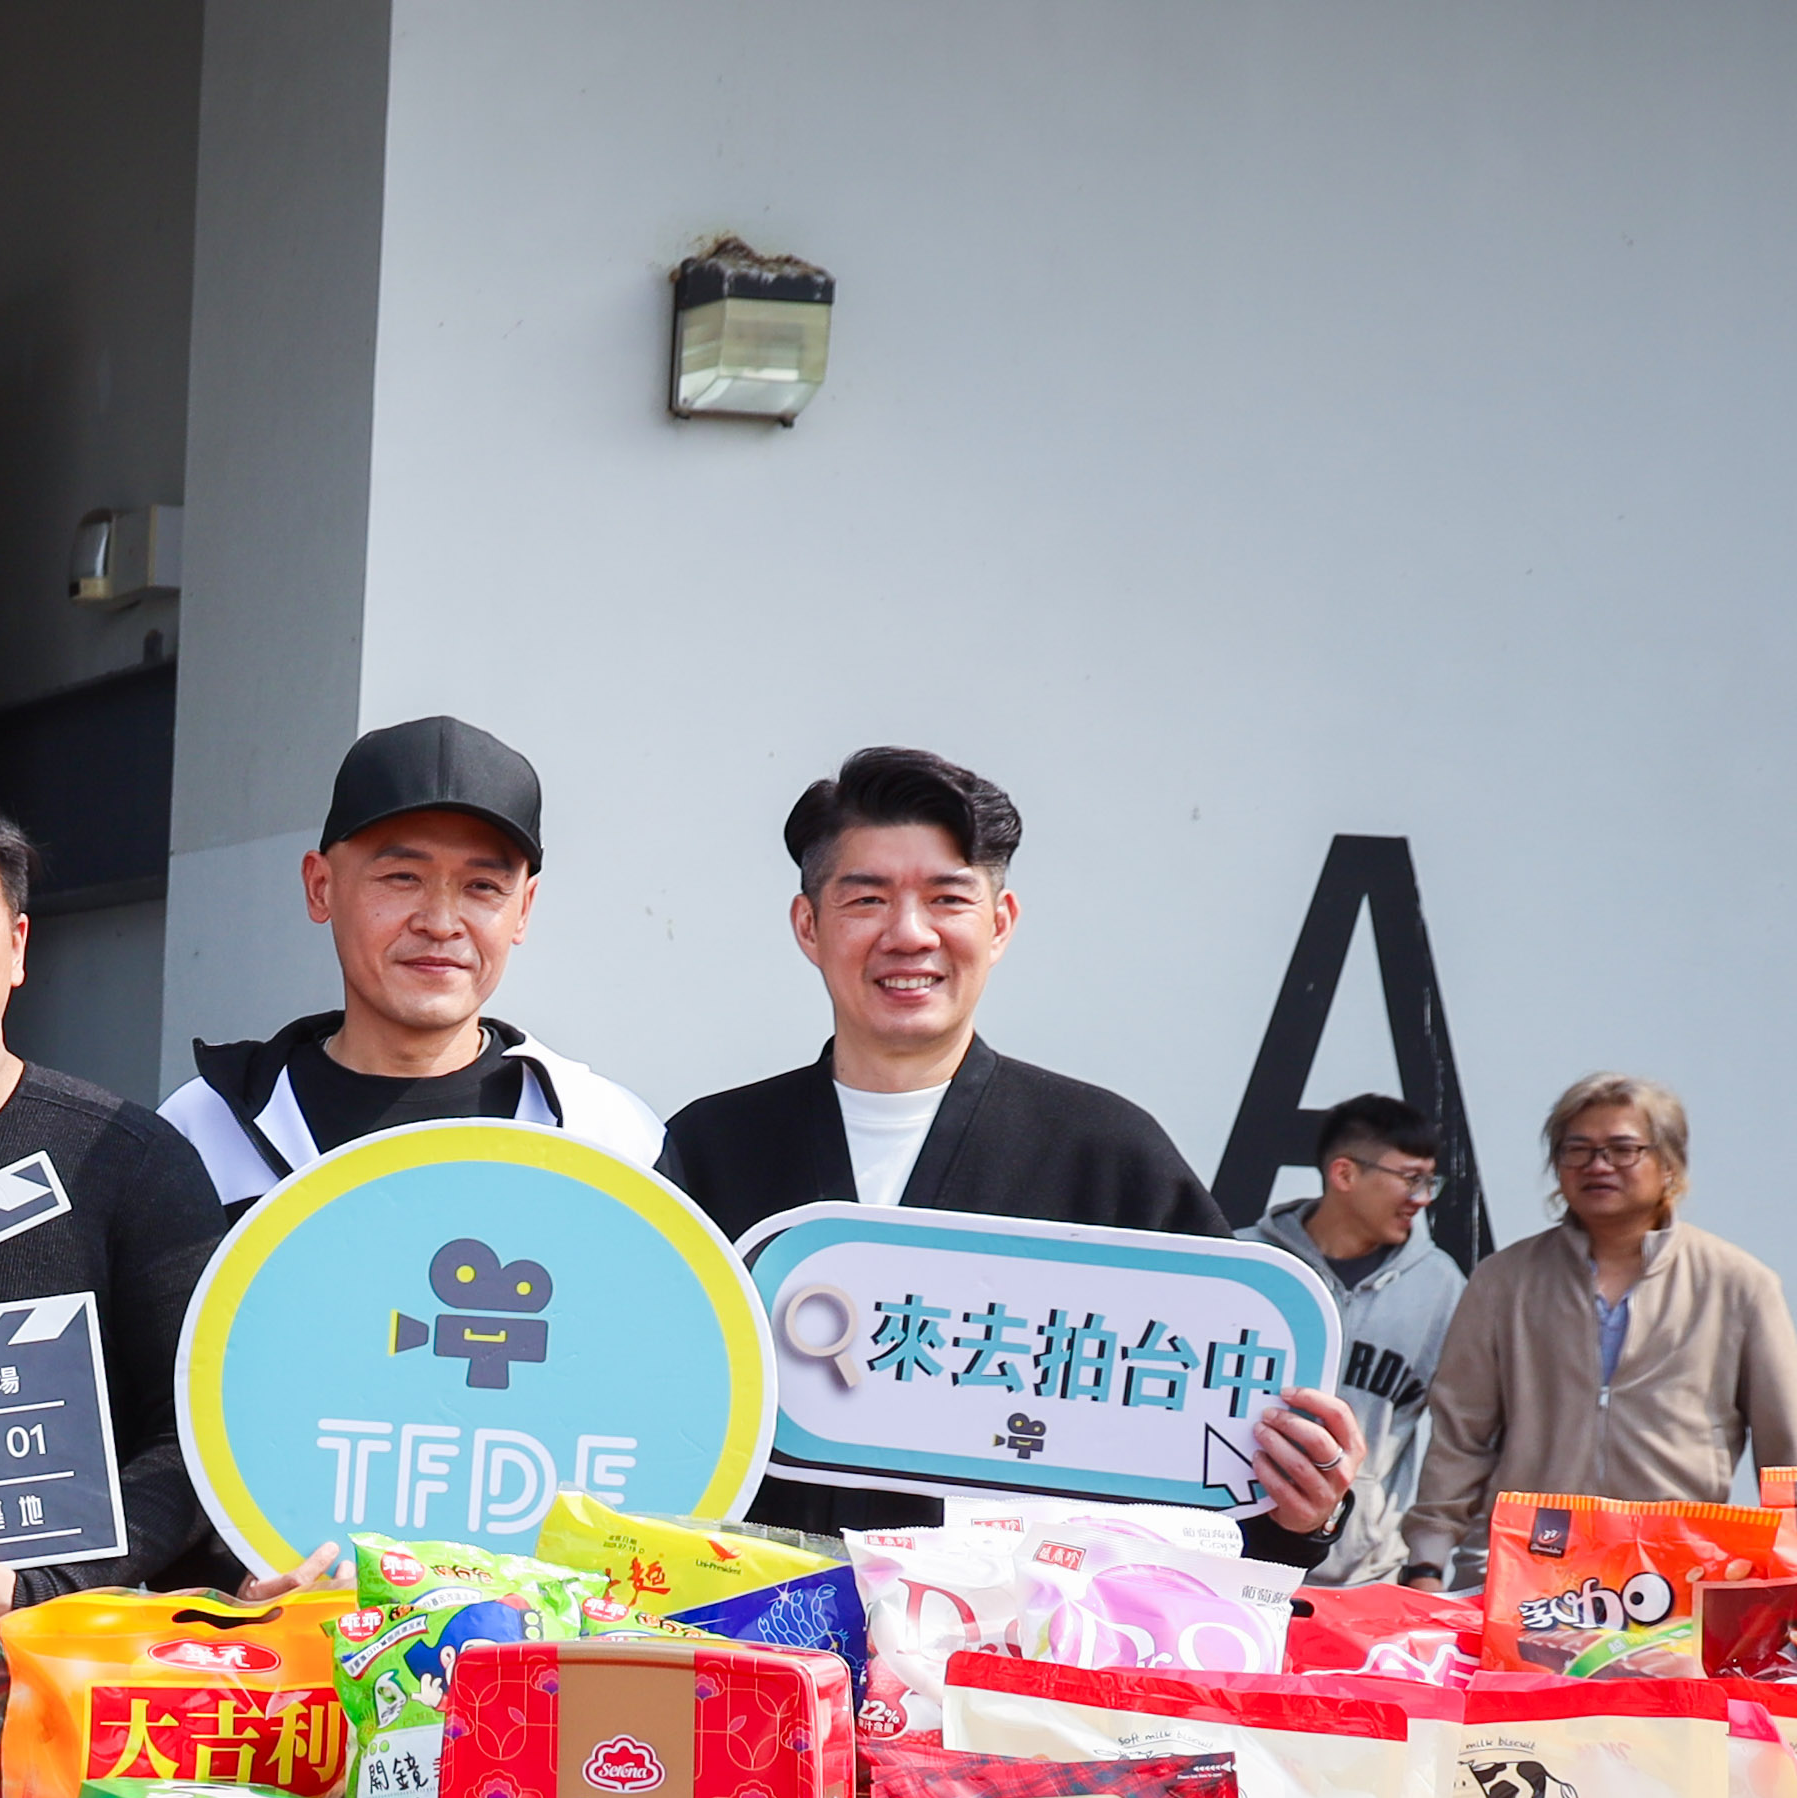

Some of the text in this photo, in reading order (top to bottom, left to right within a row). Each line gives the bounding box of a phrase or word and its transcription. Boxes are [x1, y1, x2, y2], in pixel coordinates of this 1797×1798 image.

[1211, 834, 1498, 1278] A
[867, 1293, 1289, 1418] 來去拍台中
[6, 1424, 47, 1457] 01
[340, 1611, 383, 1631] 乖乖
[100, 1698, 343, 1787] 大吉利
[1498, 1736, 1537, 1751] biscuit
[598, 1761, 649, 1779] Serena
